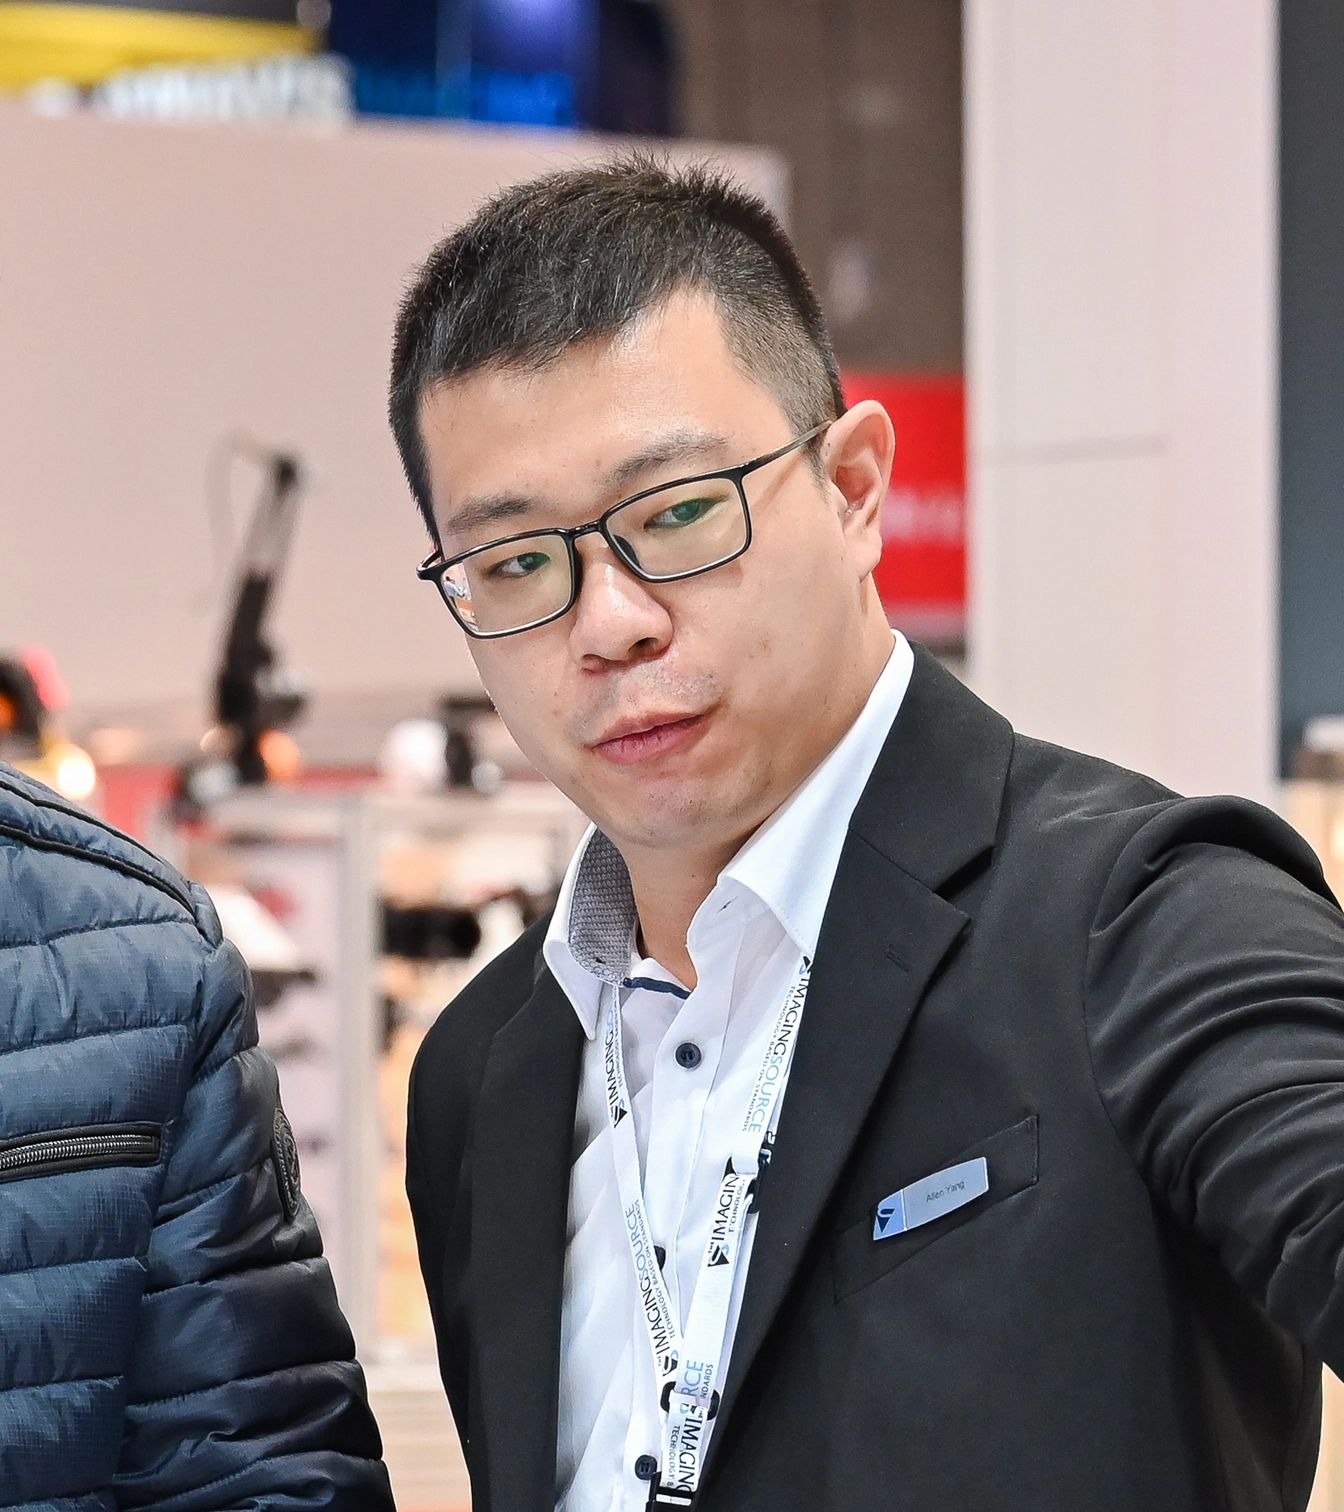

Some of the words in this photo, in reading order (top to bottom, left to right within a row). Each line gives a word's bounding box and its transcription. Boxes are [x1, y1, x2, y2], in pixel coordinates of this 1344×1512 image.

[773, 985, 796, 1039] TECHNOLOGY
[748, 976, 810, 1133] IMAGINGSOURCE
[758, 1069, 765, 1081] ON
[762, 1041, 774, 1067] BASED
[742, 1084, 760, 1132] STANDARDS
[634, 1199, 649, 1244] STANDARDS
[645, 1246, 652, 1258] ON
[647, 1260, 659, 1285] BASED
[625, 1204, 670, 1355] IMAGINGSOURCE
[655, 1287, 676, 1339] TECHNOLOGY
